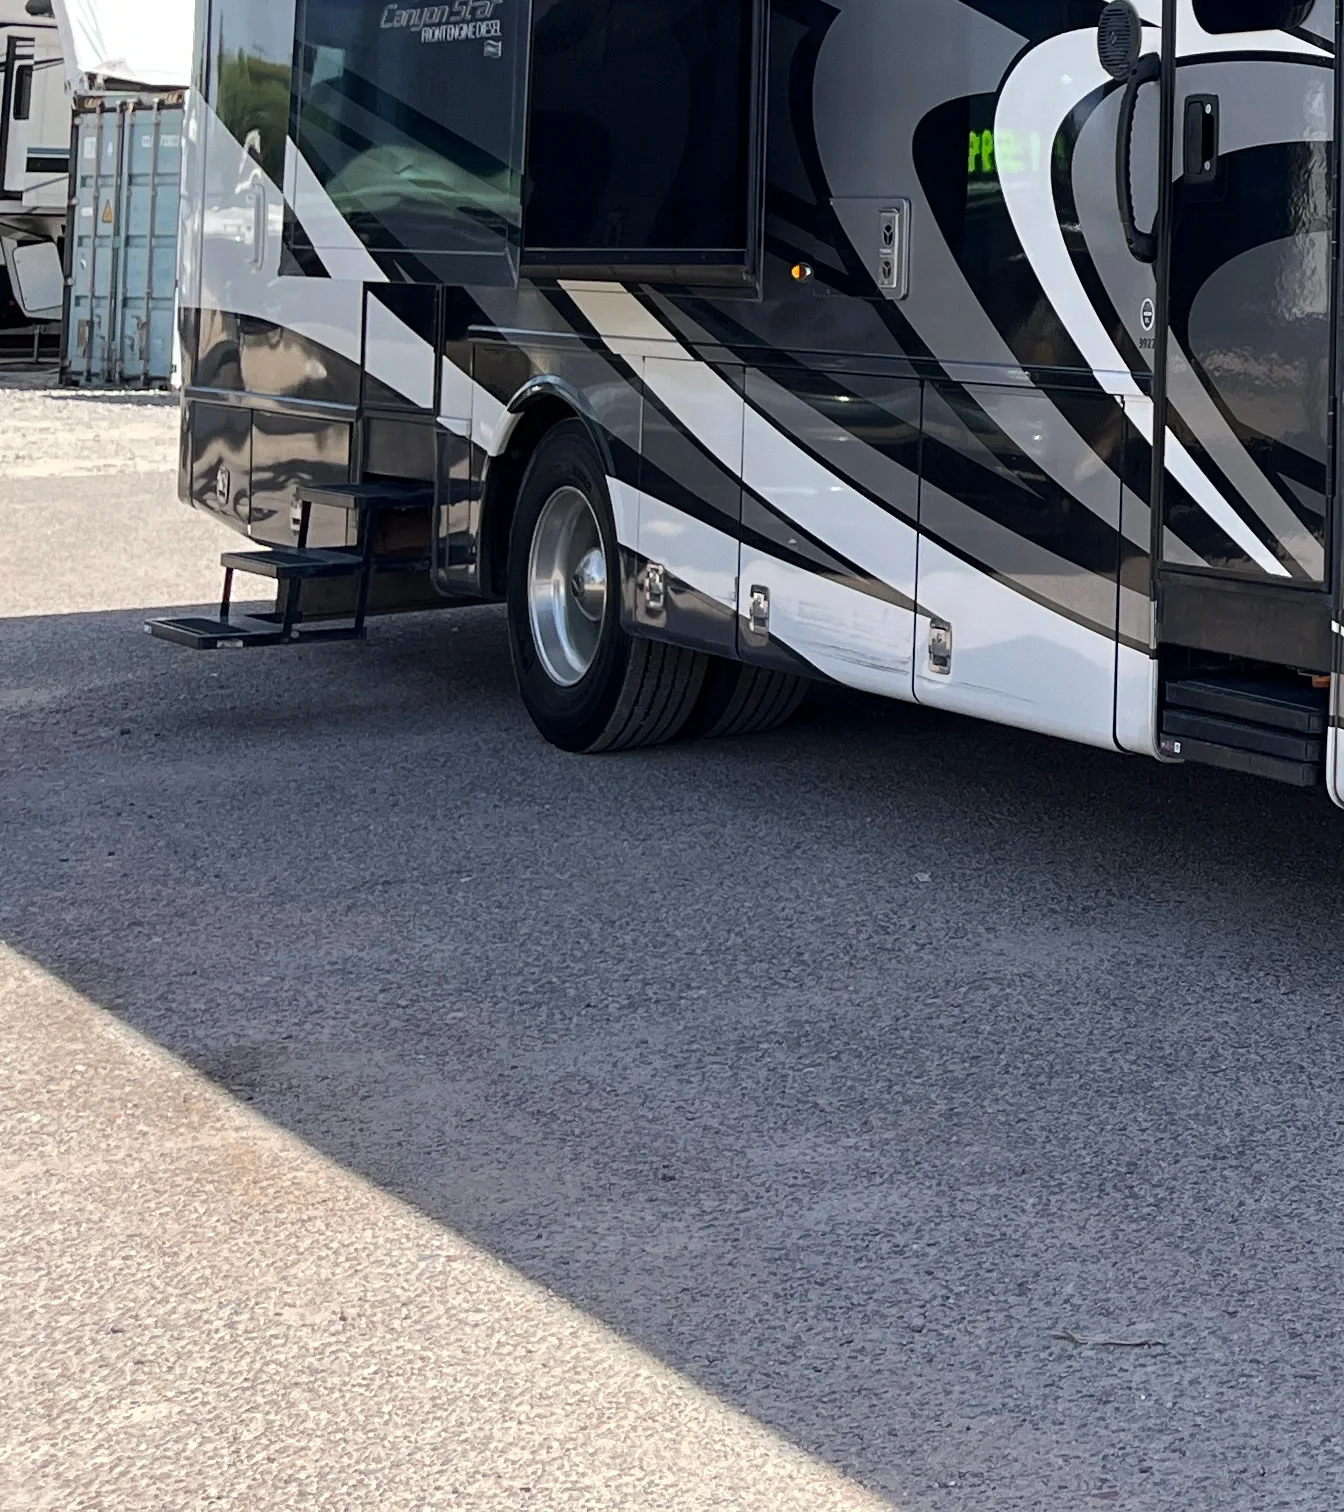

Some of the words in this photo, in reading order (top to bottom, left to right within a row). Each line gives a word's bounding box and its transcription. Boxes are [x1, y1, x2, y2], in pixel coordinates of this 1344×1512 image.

[380, 4, 449, 31] Canyon
[421, 25, 447, 43] FRONT
[475, 19, 502, 37] DIESEL
